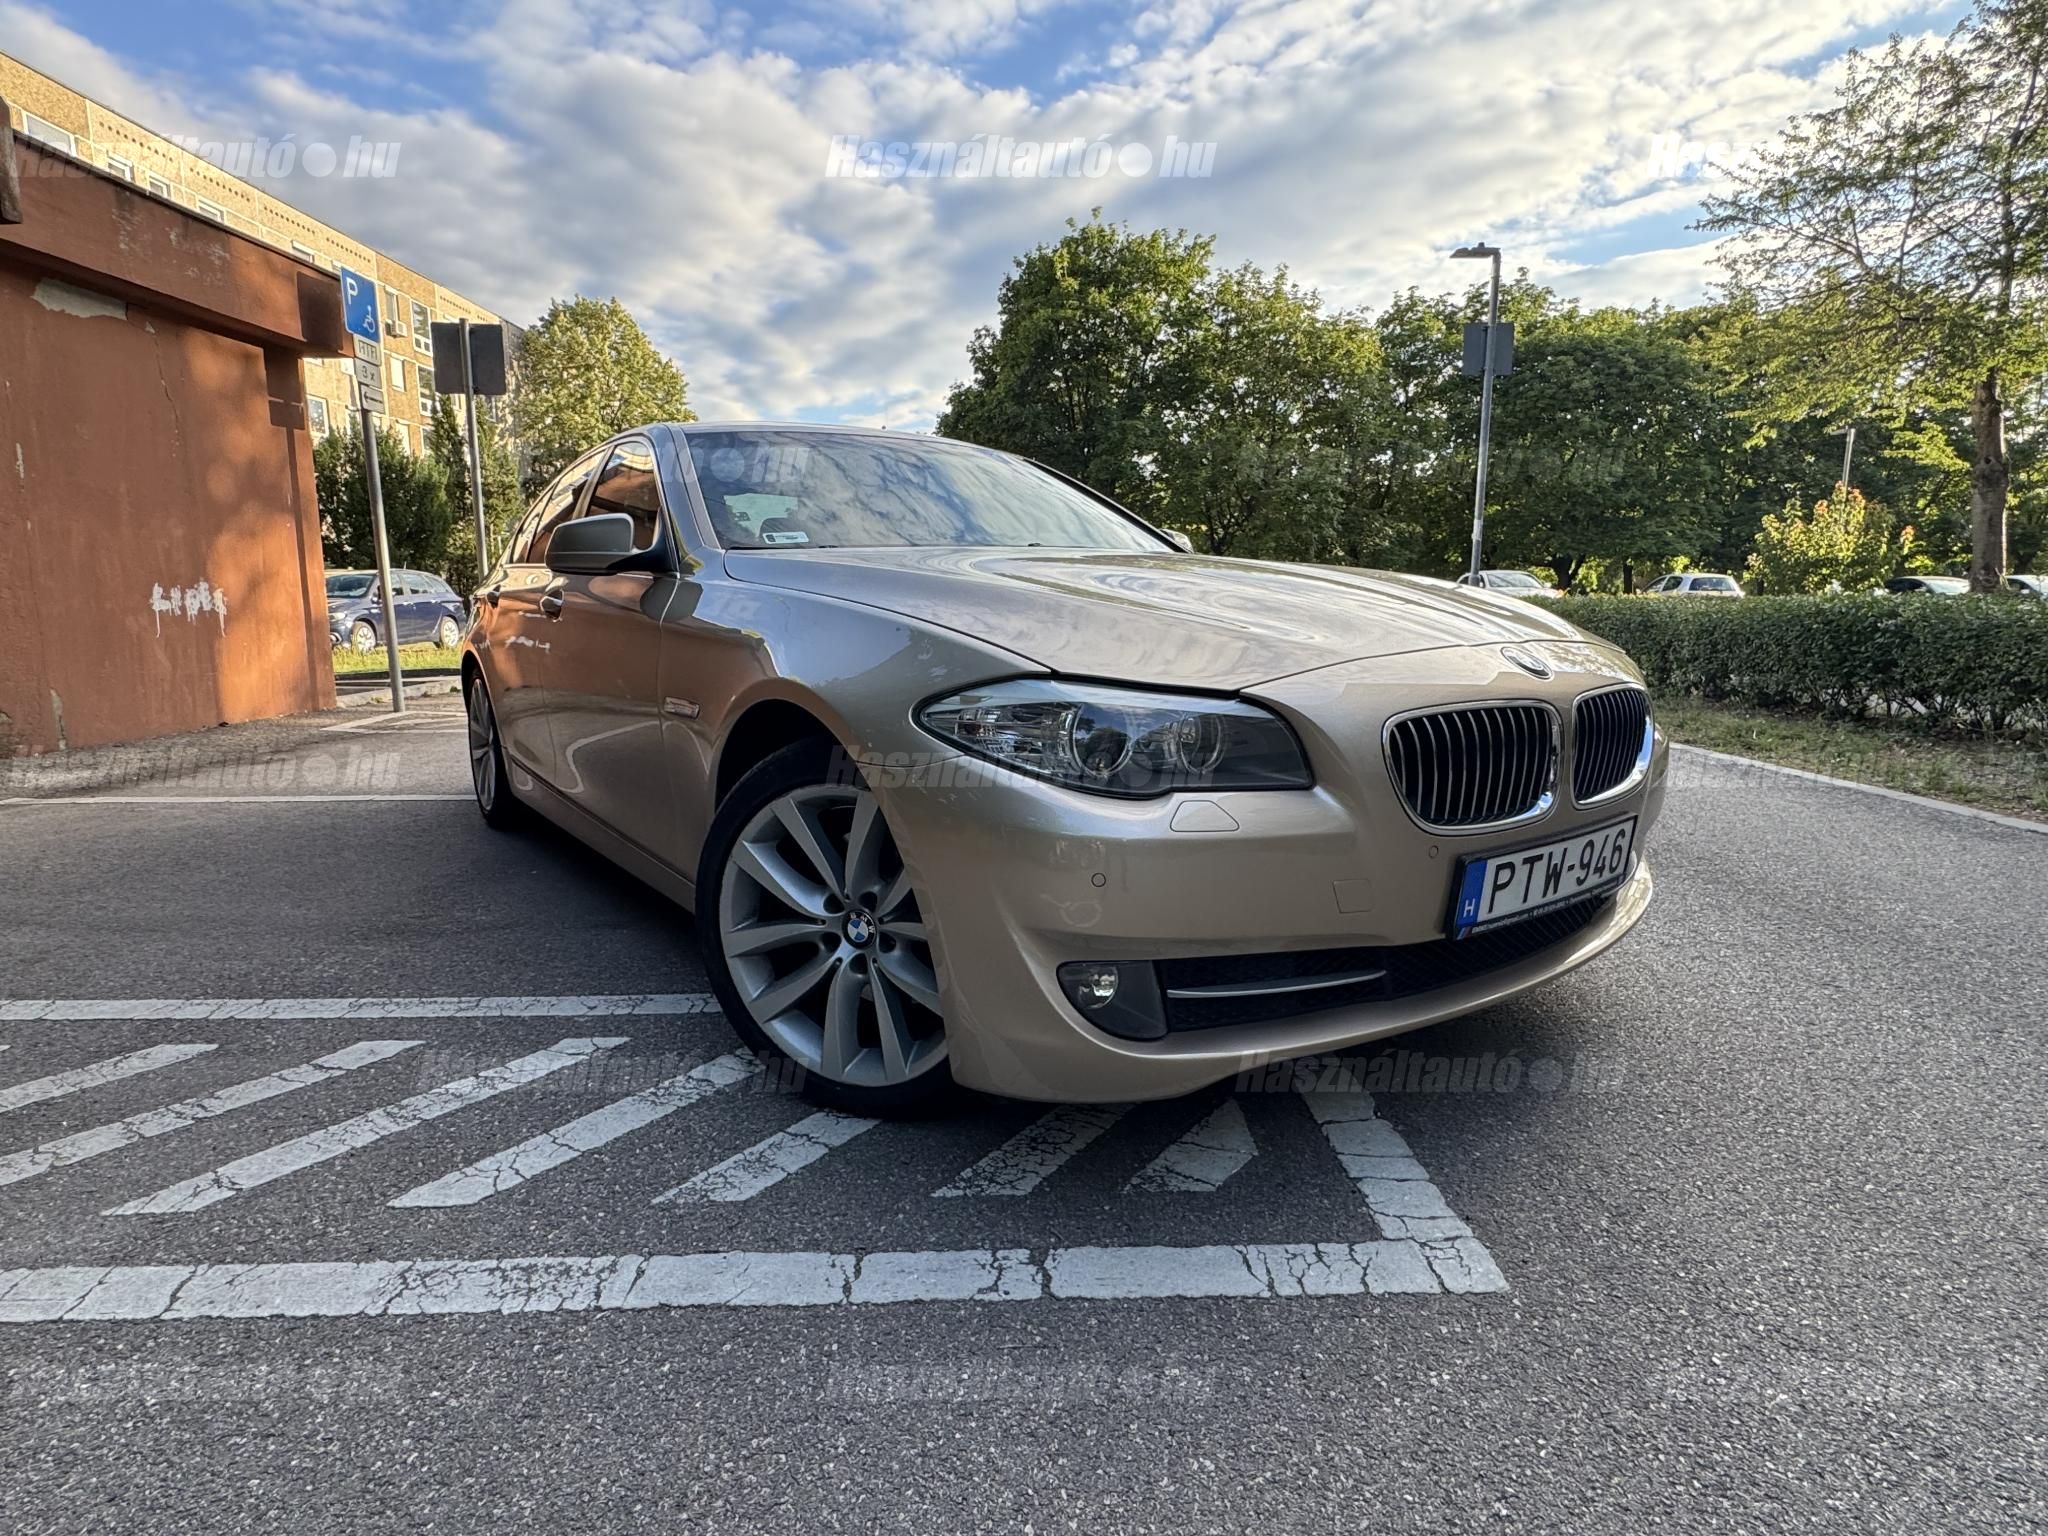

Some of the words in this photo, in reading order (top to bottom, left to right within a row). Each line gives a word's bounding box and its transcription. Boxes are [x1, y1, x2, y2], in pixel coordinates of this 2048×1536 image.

[346, 277, 358, 305] P
[1487, 828, 1626, 914] PTW-946
[1463, 899, 1475, 917] H
